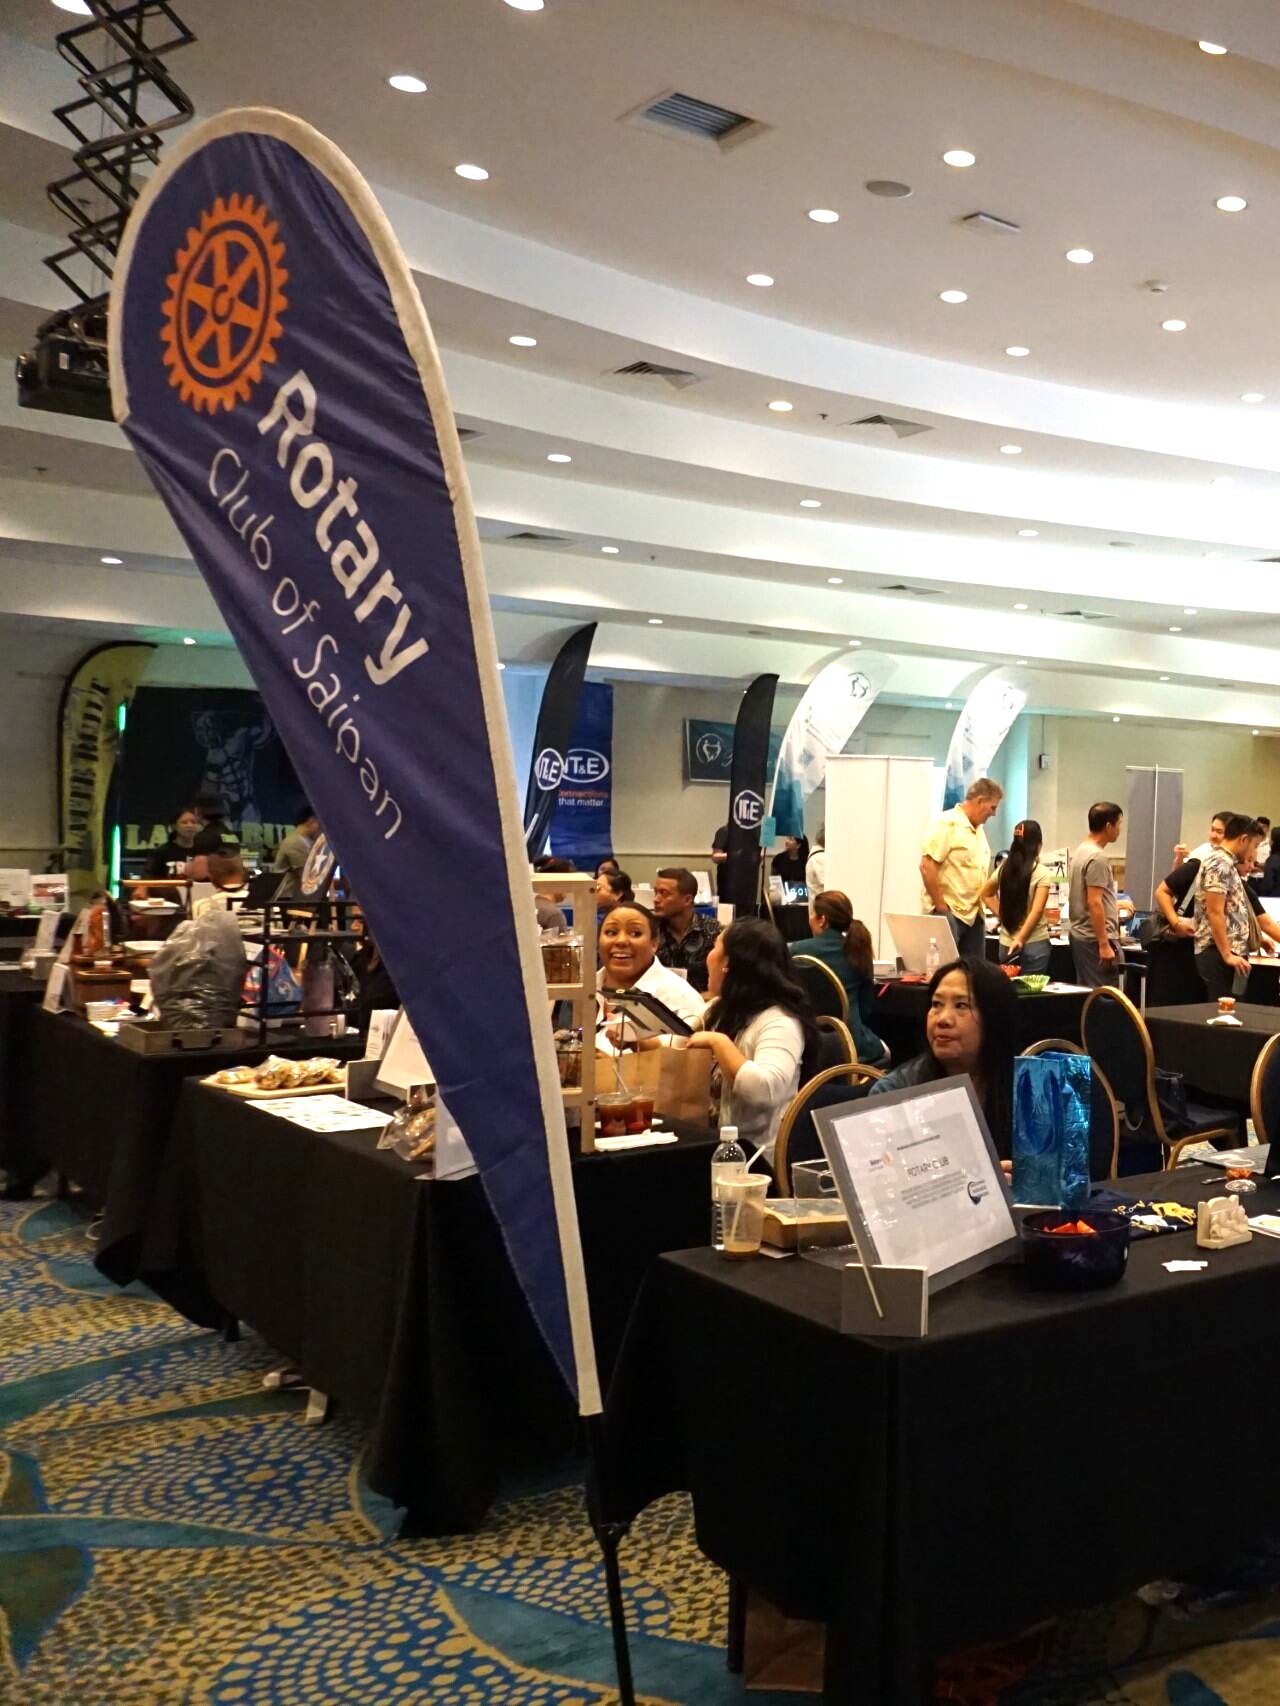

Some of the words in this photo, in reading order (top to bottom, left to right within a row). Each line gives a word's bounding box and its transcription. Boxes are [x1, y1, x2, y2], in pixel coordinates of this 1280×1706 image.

[208, 448, 274, 570] Club
[257, 368, 429, 685] Rotary
[272, 577, 320, 634] of
[292, 634, 402, 839] Saipan
